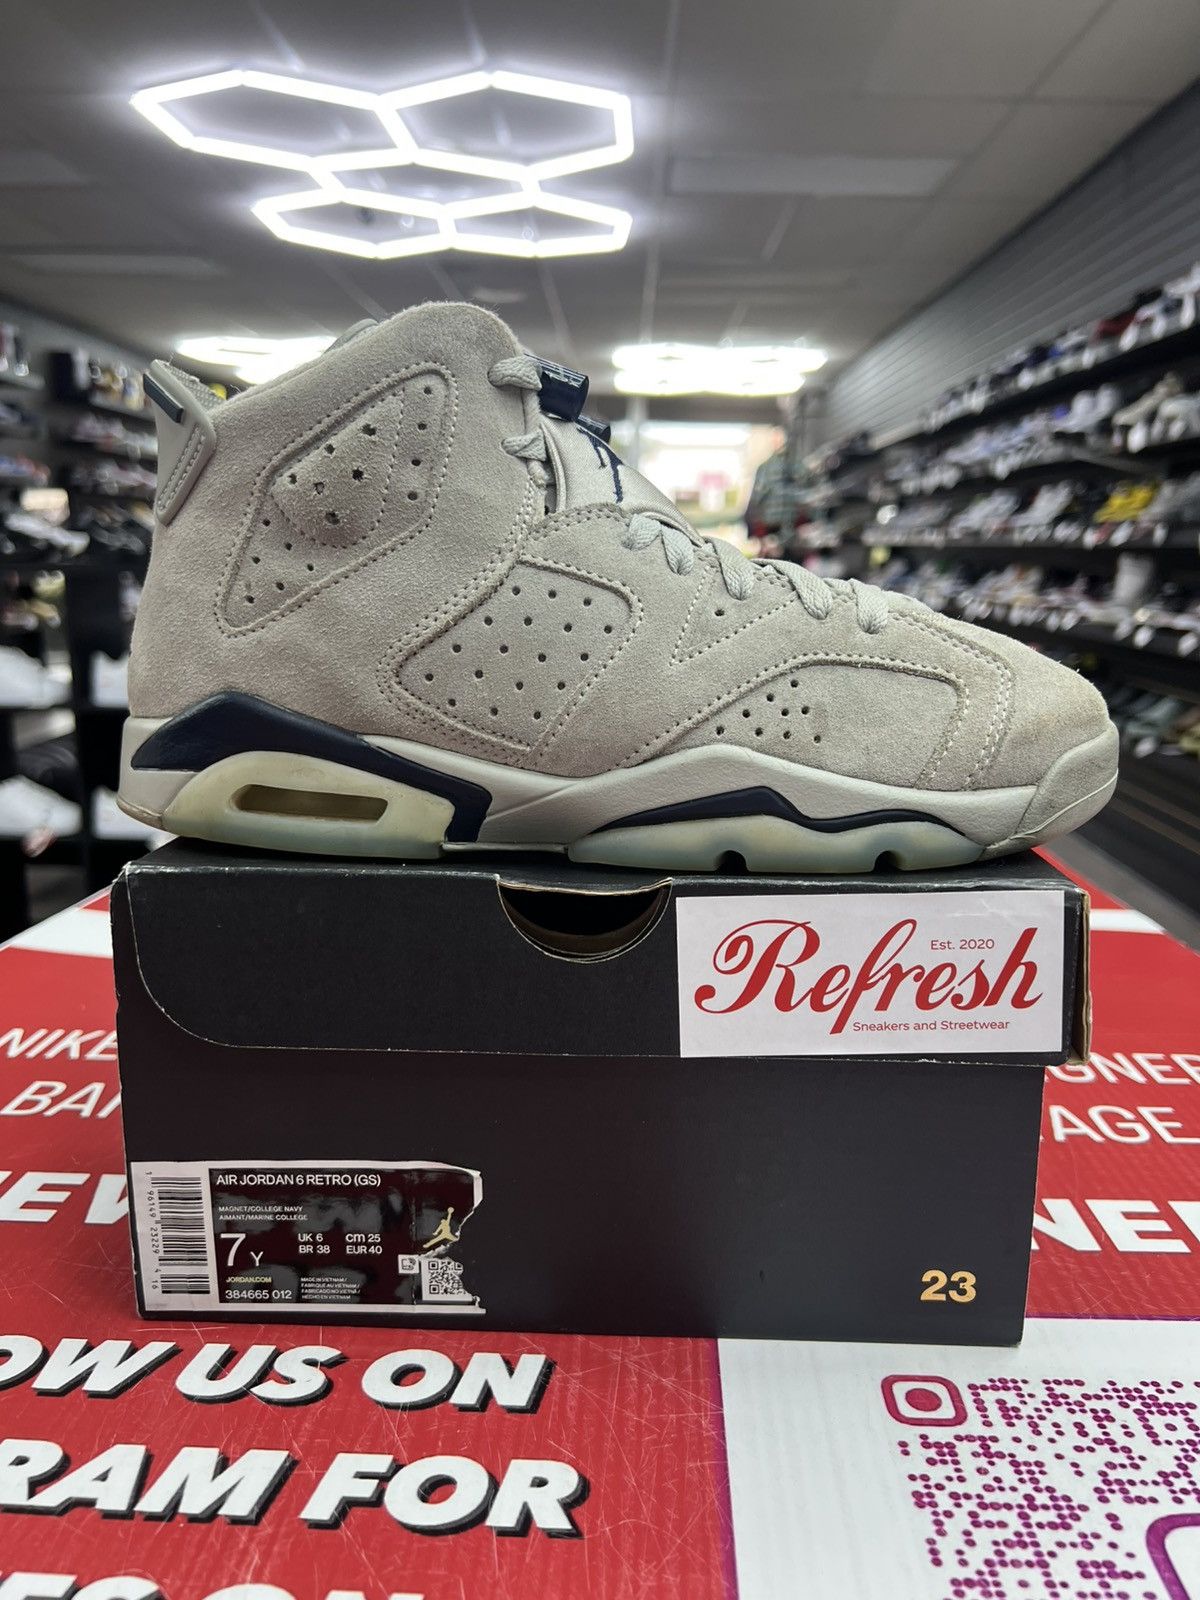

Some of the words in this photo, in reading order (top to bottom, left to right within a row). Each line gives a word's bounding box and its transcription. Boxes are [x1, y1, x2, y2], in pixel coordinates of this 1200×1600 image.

[930, 939, 956, 950] Est.
[959, 938, 995, 950] 2020
[694, 918, 1044, 1035] Refresh
[852, 1020, 910, 1032] Sneakers
[913, 1019, 937, 1031] and
[940, 1018, 1010, 1031] Streetwear
[1040, 1105, 1200, 1144] AGE
[216, 1174, 238, 1185] AIR
[240, 1174, 294, 1185] JORDAN
[296, 1174, 305, 1185] 6
[306, 1174, 352, 1185] RETRO
[354, 1174, 381, 1187] (GS)
[1031, 1198, 1200, 1253] NE
[150, 1227, 160, 1254] 23229
[298, 1233, 313, 1242] UK
[316, 1233, 324, 1242] 6
[367, 1234, 381, 1243] 25
[220, 1233, 246, 1267] 7
[250, 1251, 264, 1267] Y
[299, 1245, 313, 1254] BR
[316, 1245, 331, 1254] 38
[346, 1245, 367, 1254] EUR
[368, 1245, 383, 1254] 40
[225, 1290, 270, 1299] 384665
[272, 1290, 292, 1299] 012
[920, 1269, 977, 1303] 23
[176, 1343, 342, 1400] US
[361, 1348, 546, 1407] ON
[300, 1453, 583, 1531] FOR
